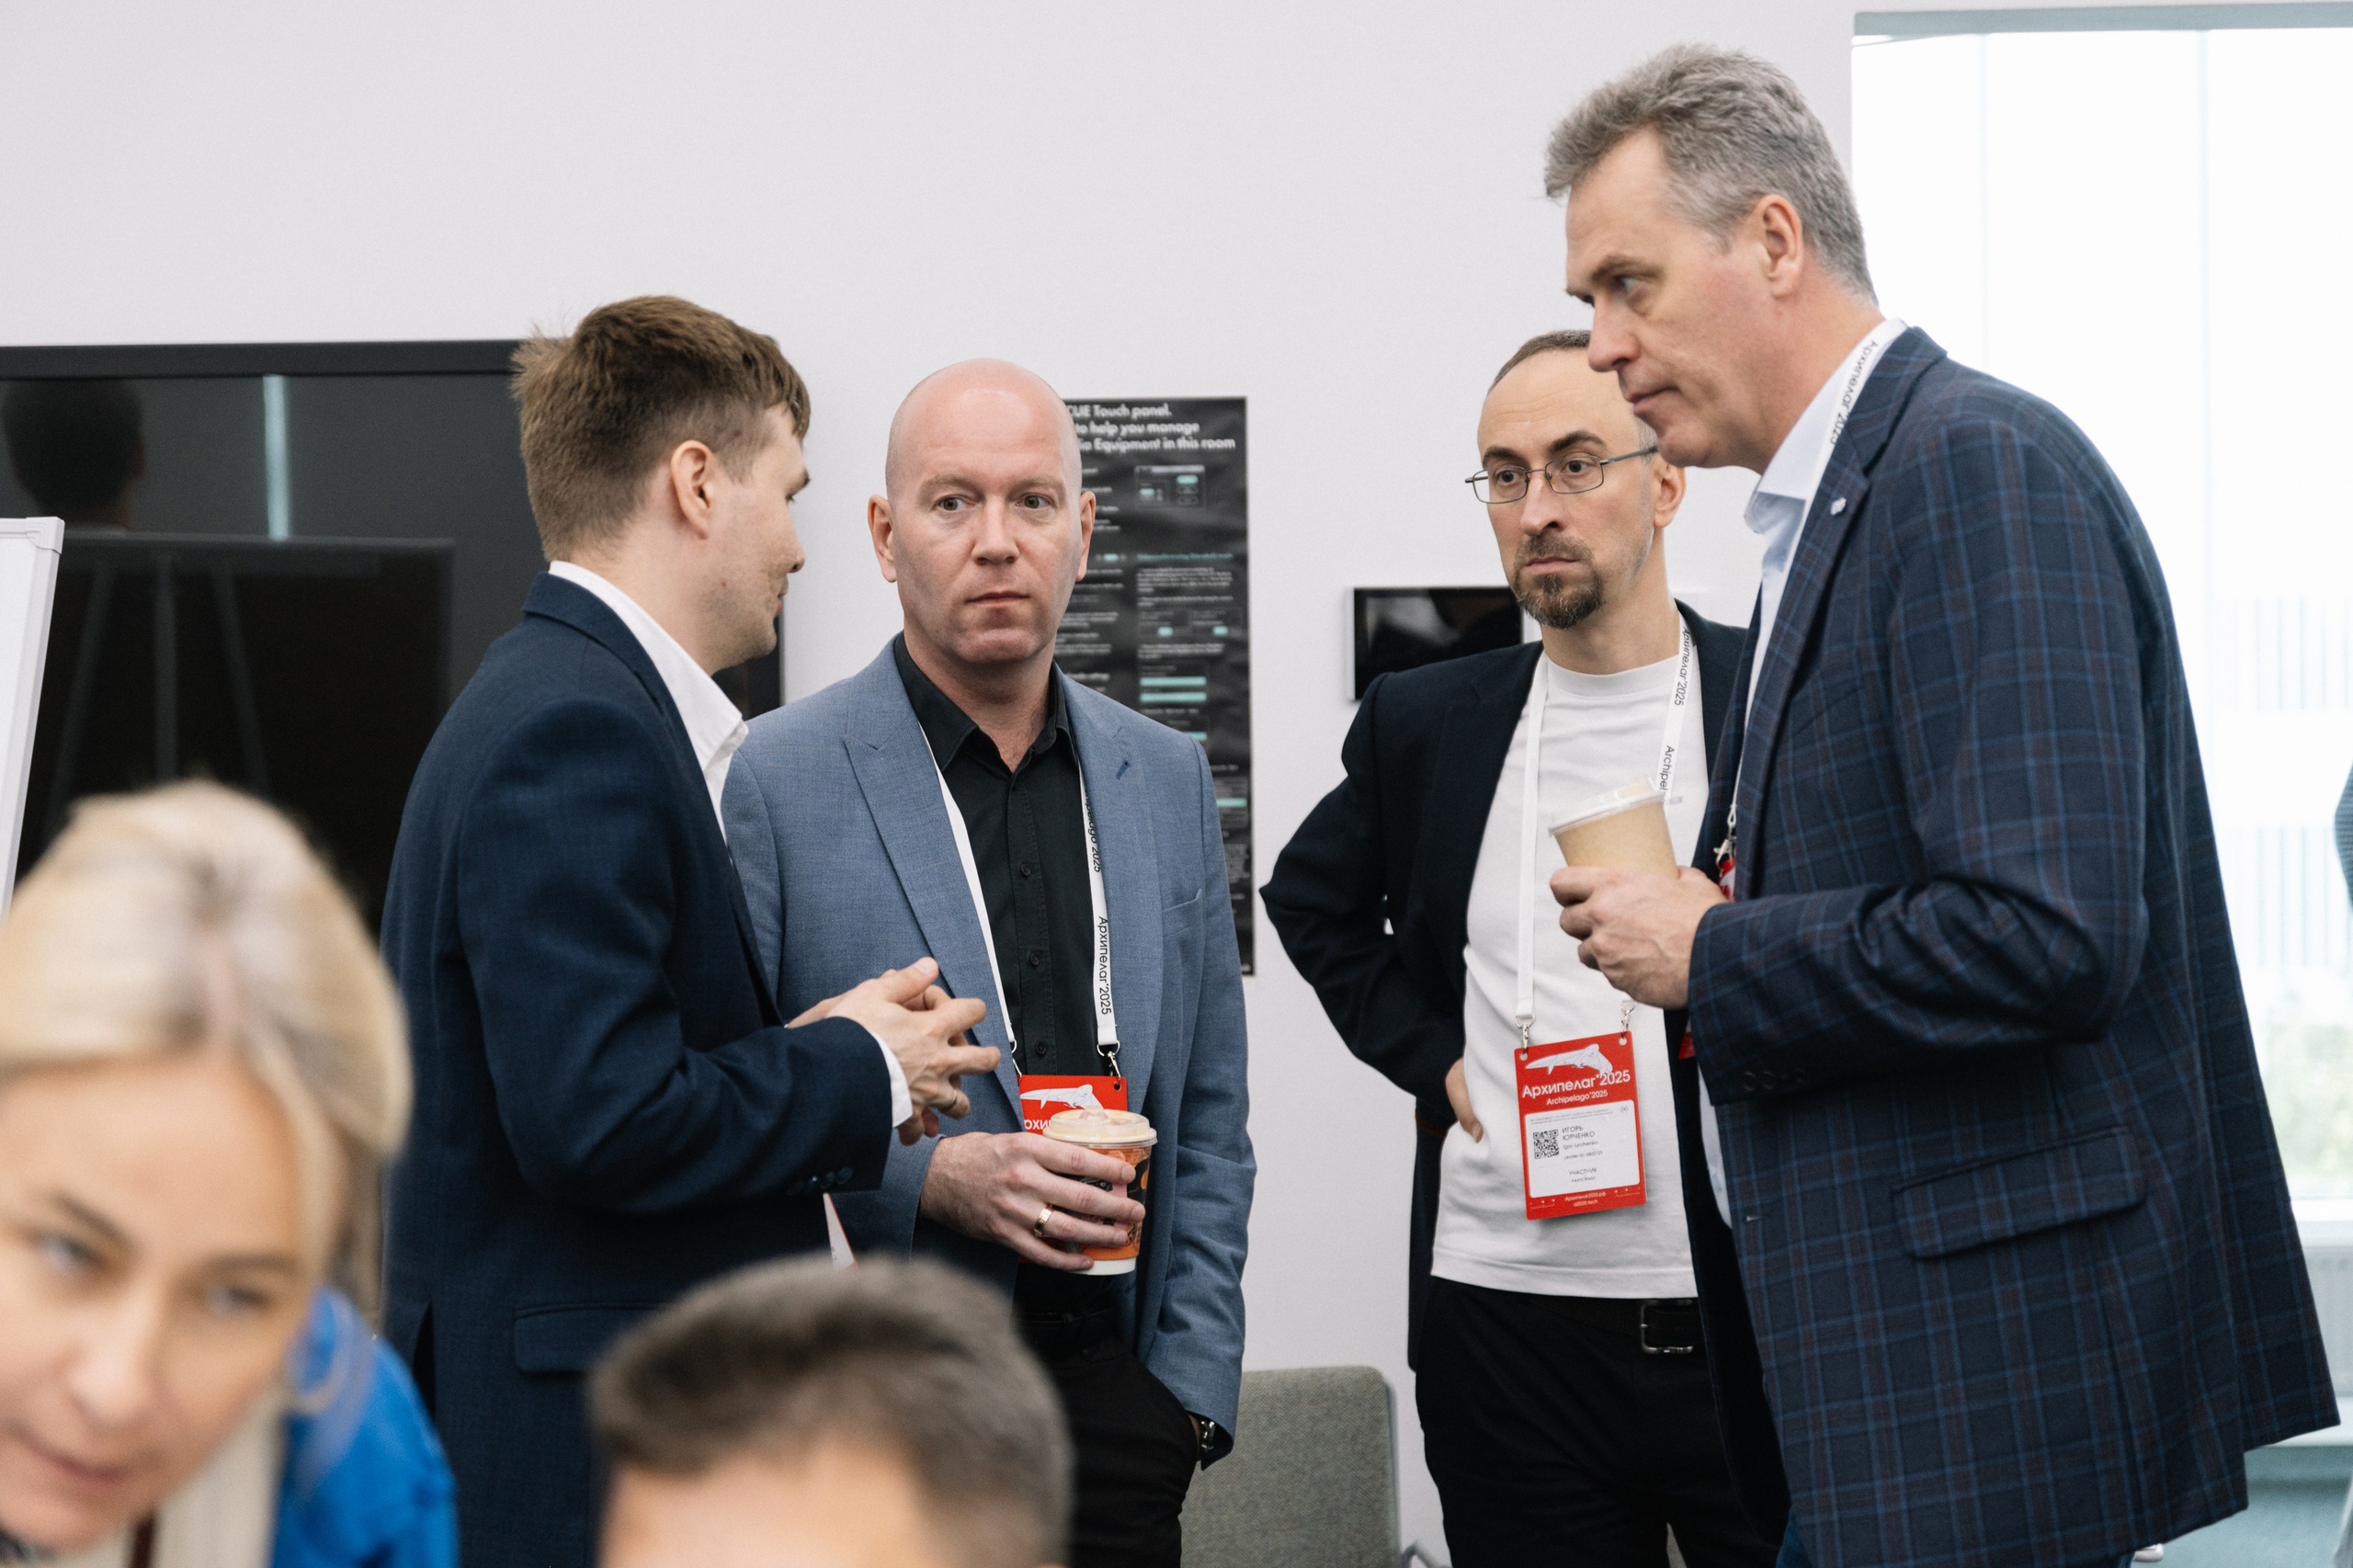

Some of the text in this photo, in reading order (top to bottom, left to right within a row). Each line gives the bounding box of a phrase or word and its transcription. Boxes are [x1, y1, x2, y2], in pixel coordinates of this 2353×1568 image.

[1093, 403, 1131, 417] Touch
[1089, 420, 1119, 438] help
[1119, 424, 1145, 438] you
[1146, 423, 1200, 440] manage
[1094, 437, 1161, 455] Equipment
[1162, 437, 1176, 450] in
[1176, 436, 1199, 450] this
[1200, 438, 1236, 450] room
[1659, 744, 1676, 792] Archipel
[1562, 1125, 1584, 1133] ИГОРЬ
[1563, 1131, 1596, 1141] ЮРЧЕНКО
